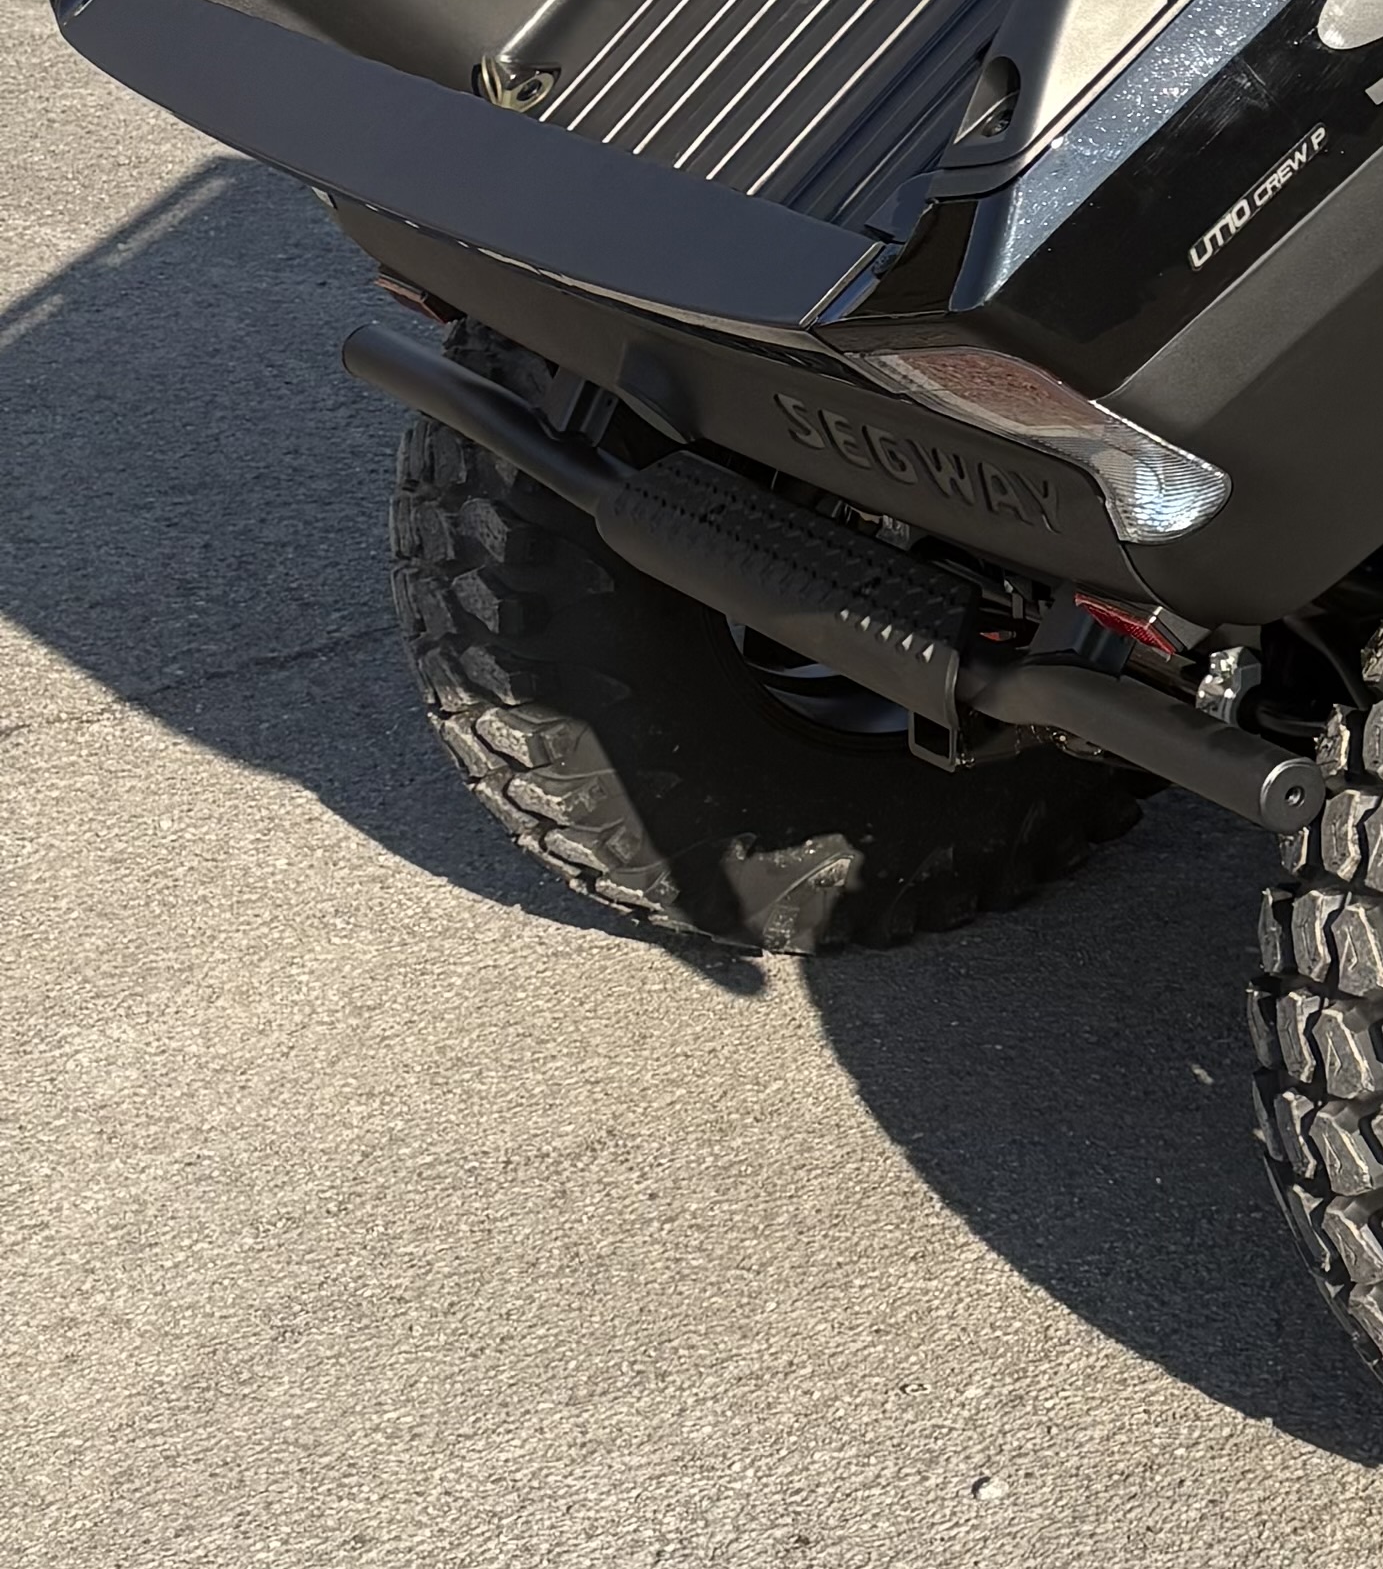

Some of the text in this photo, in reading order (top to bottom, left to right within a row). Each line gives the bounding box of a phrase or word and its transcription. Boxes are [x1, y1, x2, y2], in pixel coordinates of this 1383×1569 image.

[1253, 142, 1308, 207] CREW
[1309, 126, 1326, 151] P
[773, 392, 1060, 533] SEGWAY
